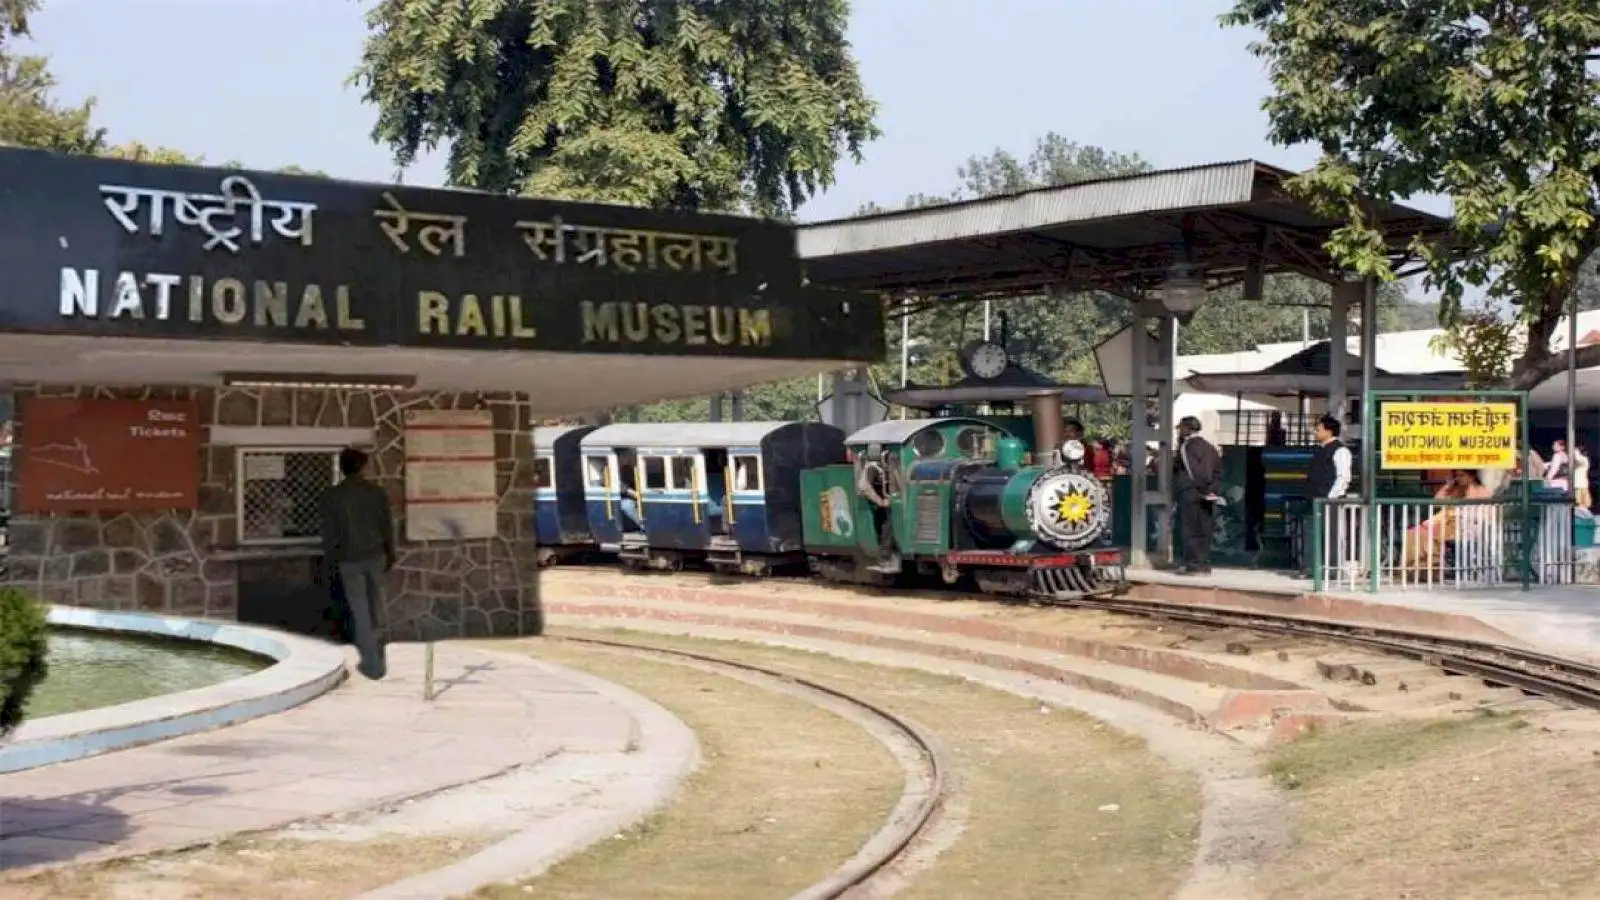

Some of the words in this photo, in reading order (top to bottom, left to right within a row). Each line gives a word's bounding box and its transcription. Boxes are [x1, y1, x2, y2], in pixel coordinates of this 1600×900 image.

[99, 175, 318, 253] राष्ट्रीय
[374, 191, 468, 257] रेल
[514, 215, 739, 275] संग्रहालय
[59, 265, 366, 331] NATIONAL
[418, 291, 537, 339] RAIL
[580, 300, 772, 347] MUSEUM
[129, 425, 187, 437] Tickets
